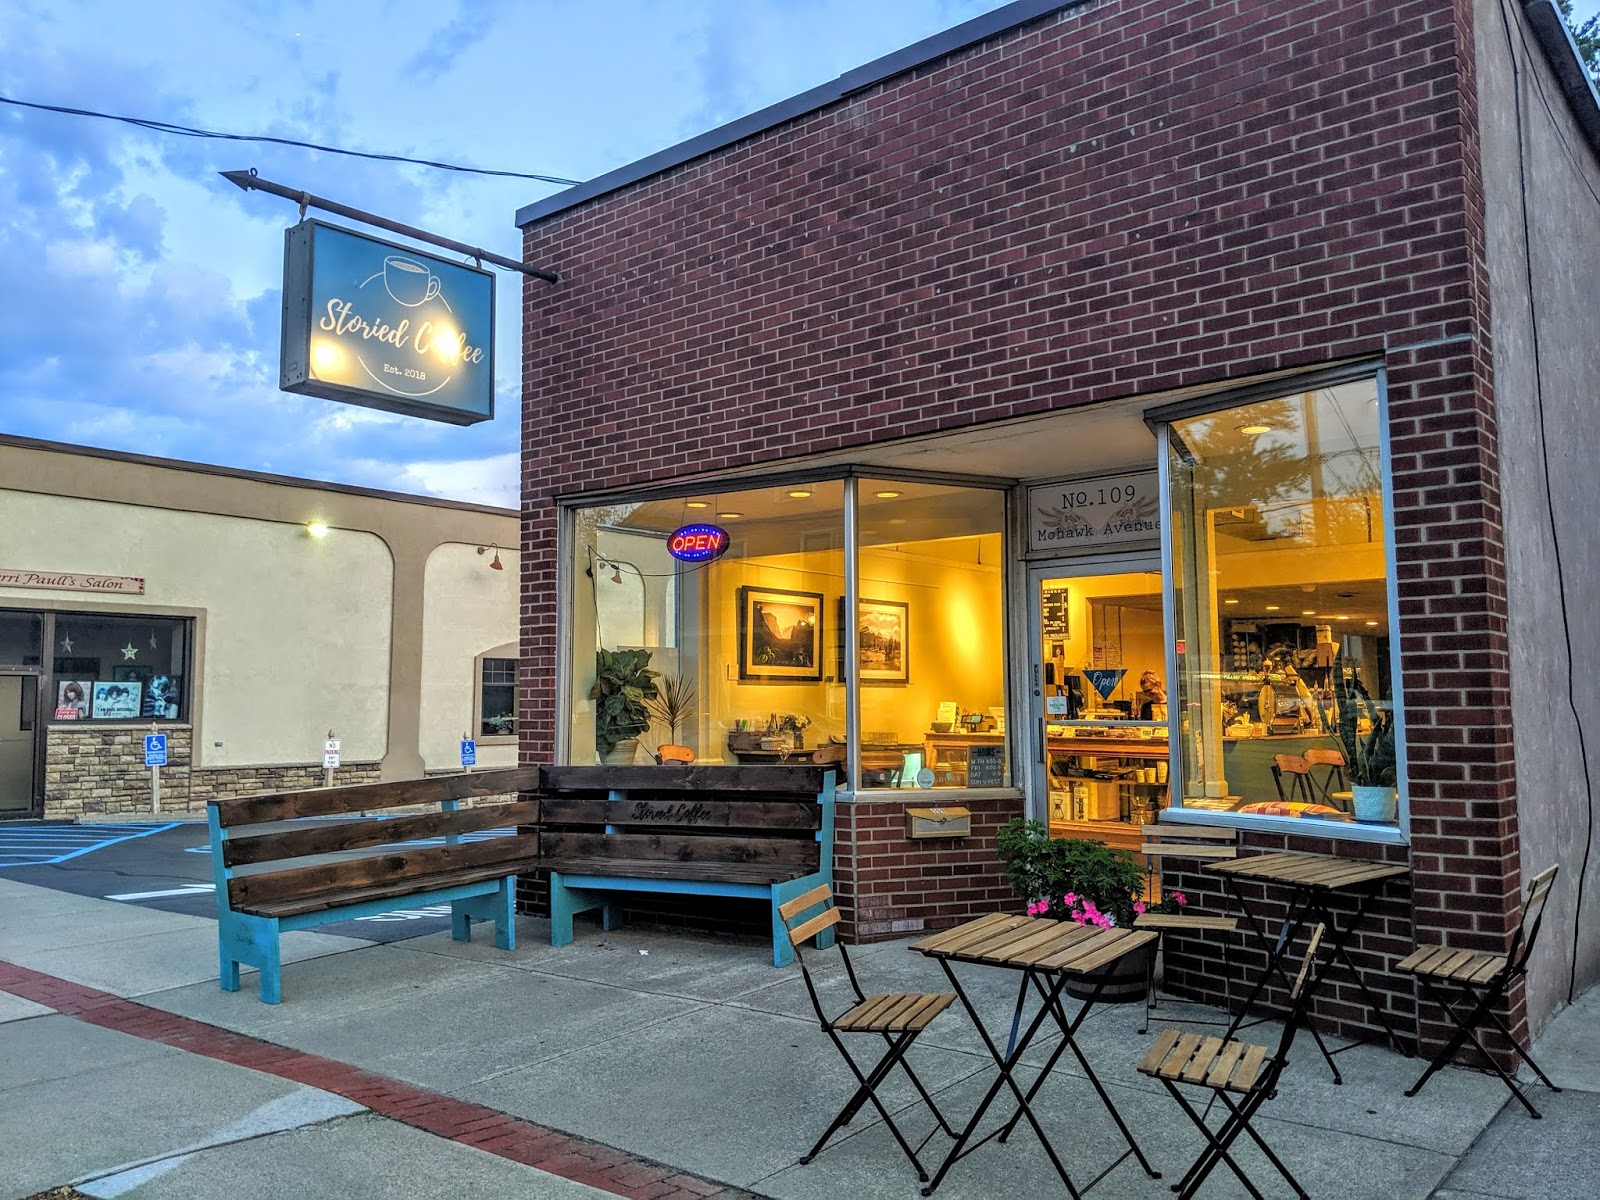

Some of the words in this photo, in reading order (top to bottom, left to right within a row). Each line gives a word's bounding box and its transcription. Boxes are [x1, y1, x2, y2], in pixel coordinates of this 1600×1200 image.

[320, 298, 409, 349] Storied
[414, 321, 484, 366] Cfee
[383, 364, 402, 376] Est.
[404, 368, 426, 381] 2018
[1038, 524, 1094, 541] Mohawk
[672, 534, 721, 551] OPEN
[0, 573, 20, 583] rri
[23, 573, 76, 587] Paull's
[80, 577, 123, 589] Salon
[1093, 671, 1119, 690] Open
